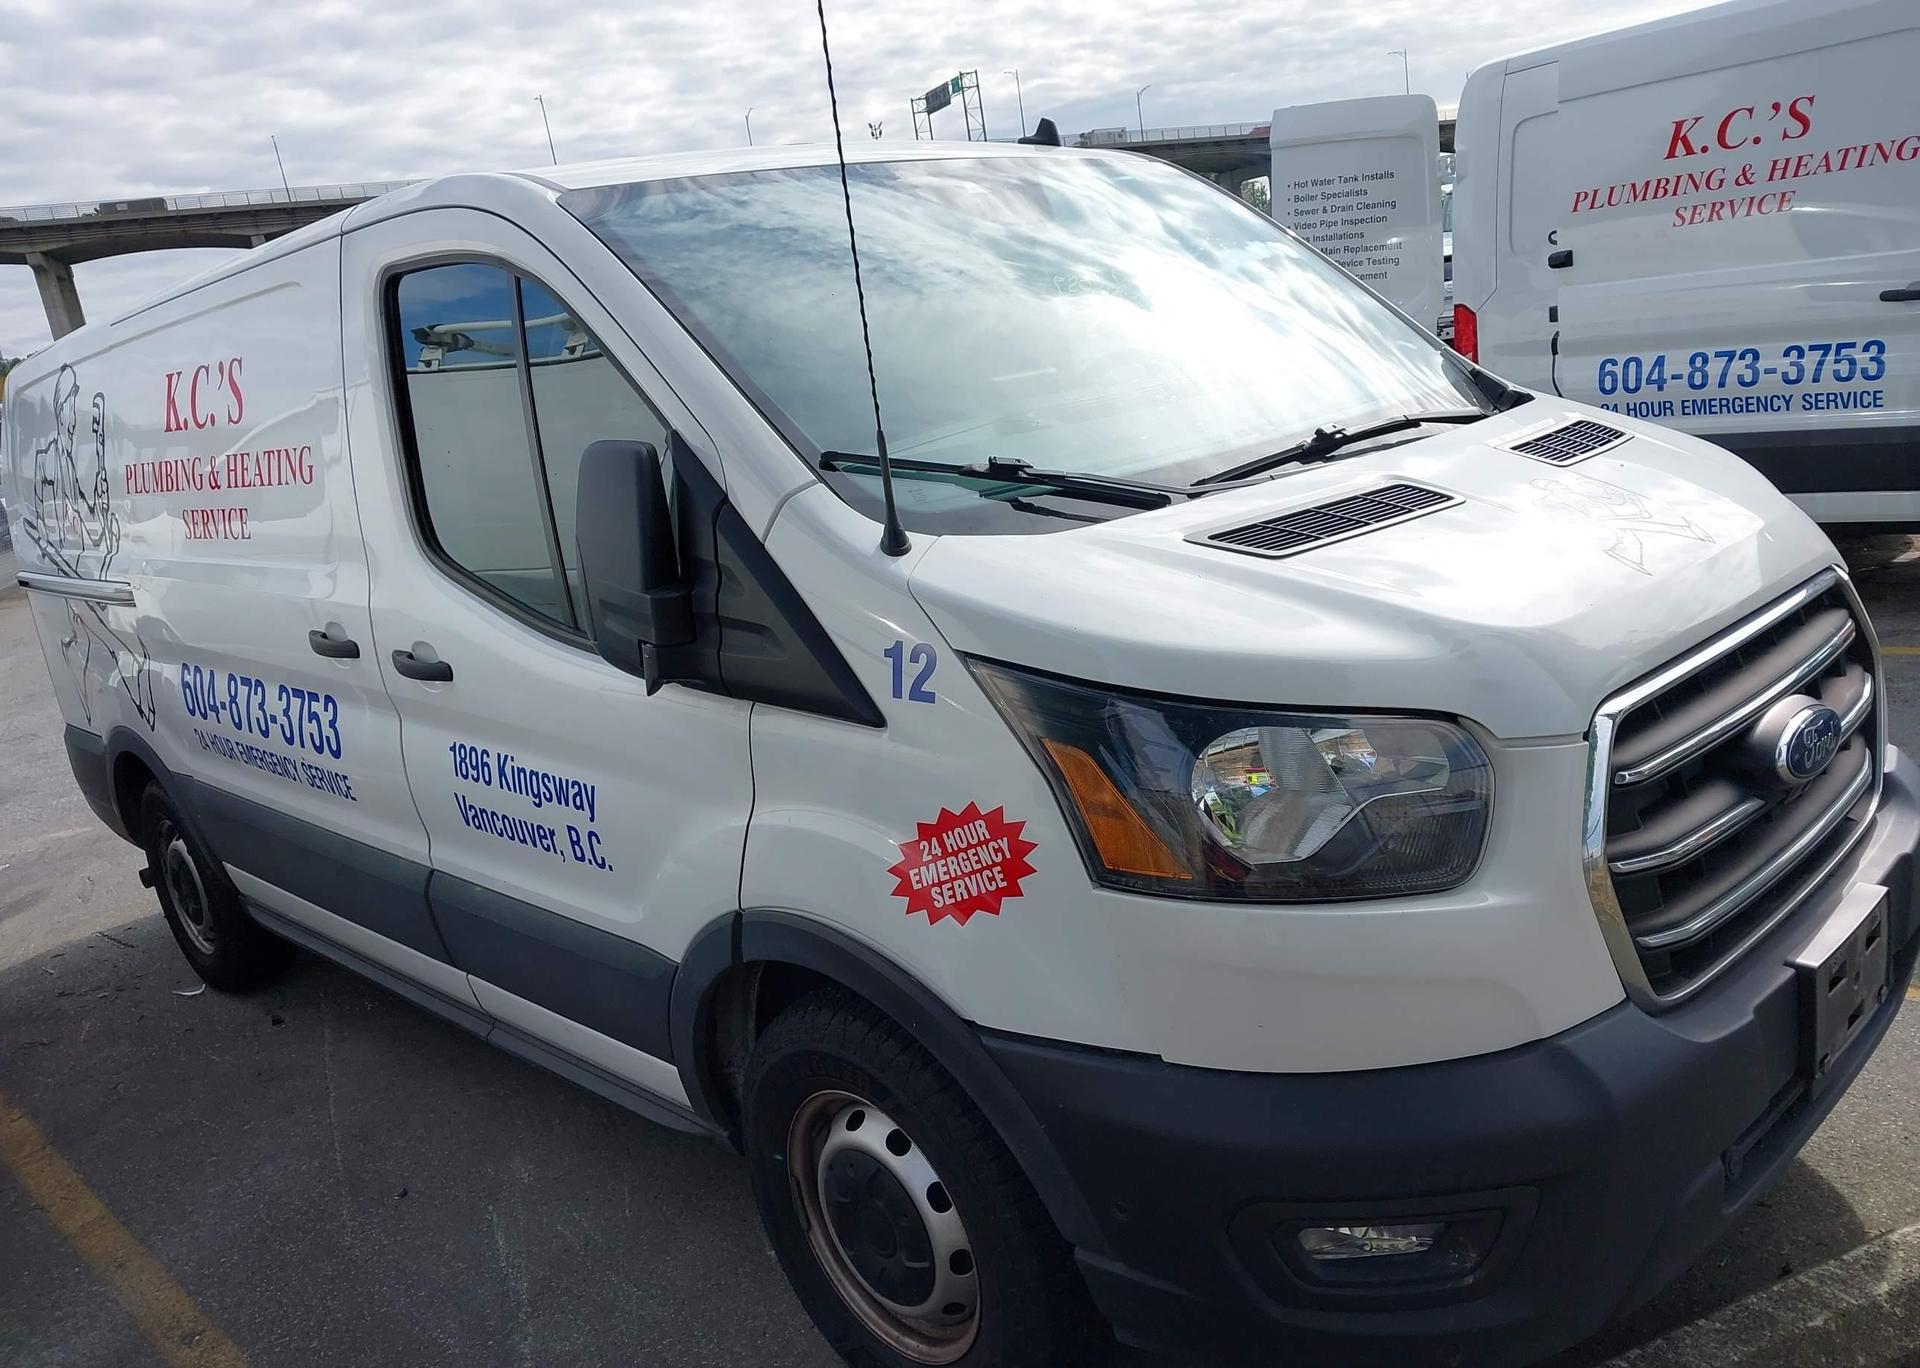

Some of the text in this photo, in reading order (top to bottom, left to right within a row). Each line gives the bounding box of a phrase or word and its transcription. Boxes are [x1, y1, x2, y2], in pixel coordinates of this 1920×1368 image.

[1664, 95, 1816, 161] K.C.'S
[1294, 171, 1395, 189] Hot Water Tank Installs
[1294, 188, 1368, 203] Boiler Specialists
[1571, 135, 1920, 213] PLUMBING & HEATING
[1294, 200, 1397, 217] Sewer & Drain Cleaning
[1294, 215, 1387, 231] Video Pipe Inspection
[1672, 190, 1797, 228] SERVICE
[1313, 231, 1365, 242] Installations
[1344, 242, 1402, 255] Replacement
[1366, 257, 1400, 266] Testing
[1598, 339, 1887, 396] 604-873-3753
[164, 357, 244, 433] K.C.'S
[1626, 400, 1674, 418] HOUR
[1681, 394, 1794, 416] EMERGENCY
[1802, 390, 1884, 411] SERVICE
[125, 445, 314, 494] PLUMBING & HEATING
[182, 508, 251, 540] SERVICE
[883, 640, 938, 704] 12
[180, 662, 343, 760] 604-873-3753
[194, 728, 358, 801] 24 HOUR EMERGENCY SERVICE
[449, 741, 596, 823] 1896 Kingsway
[454, 792, 614, 872] Vancouver, B.C.
[919, 819, 990, 862] 24 HOUR
[908, 837, 1012, 890] EMERGENCY
[930, 866, 1008, 909] SERVICE
